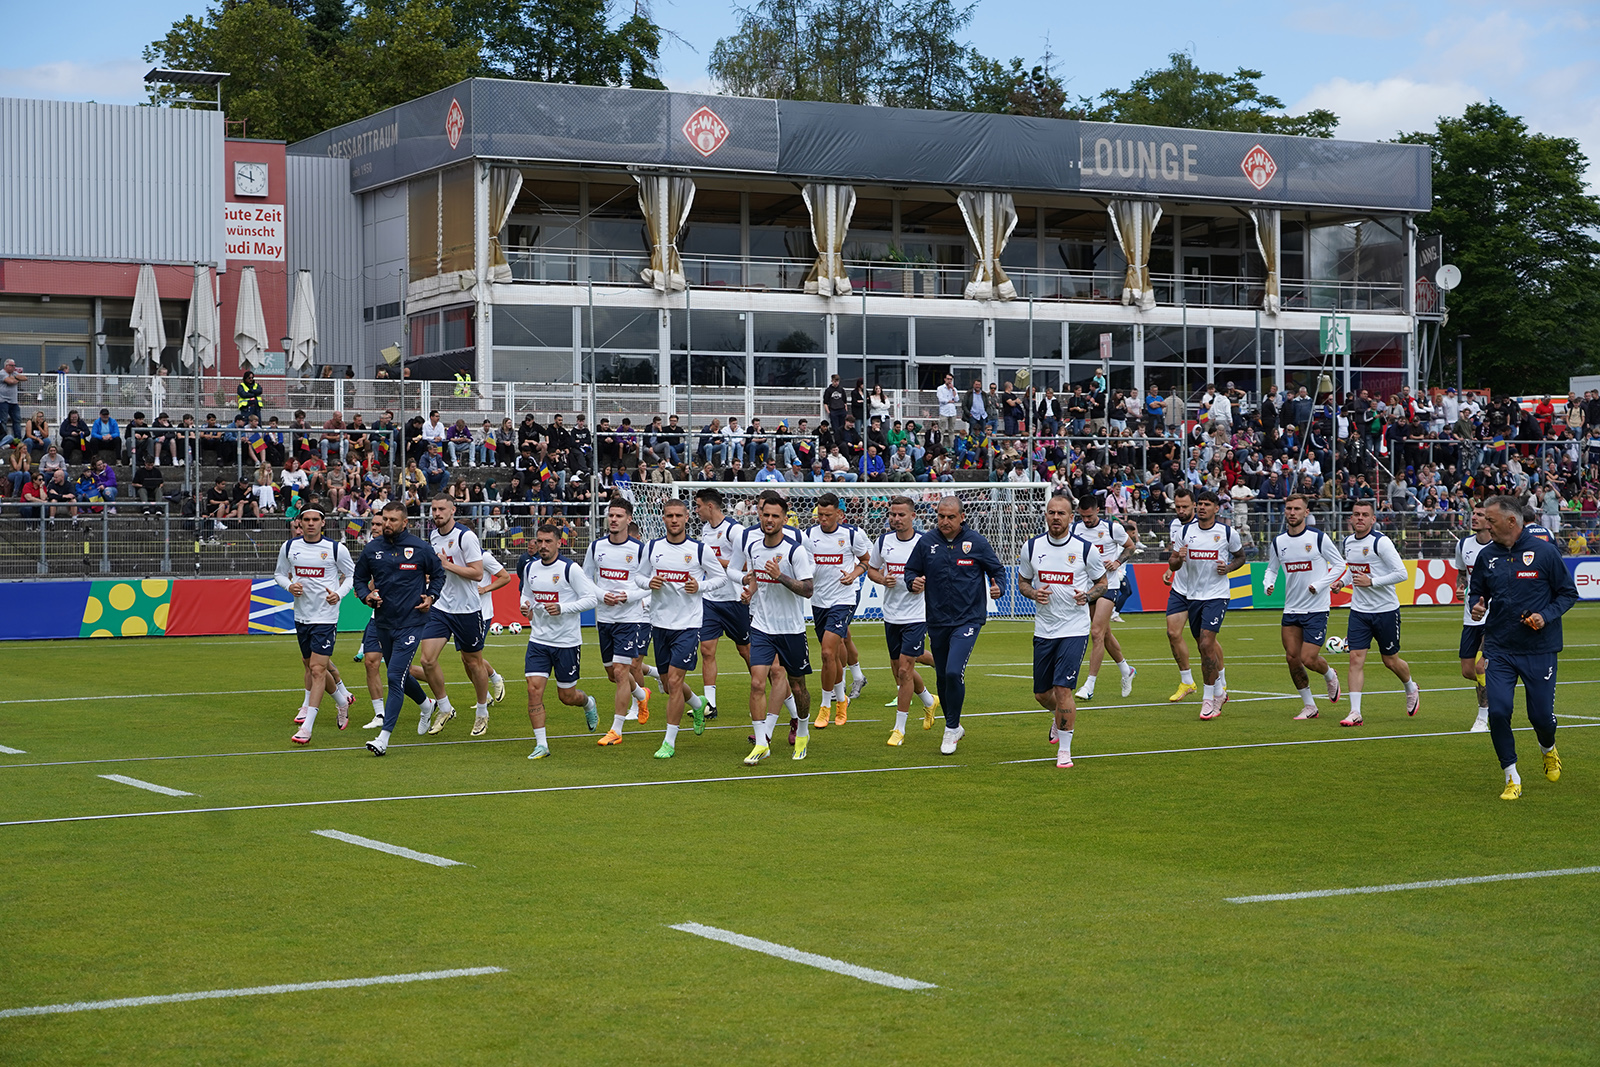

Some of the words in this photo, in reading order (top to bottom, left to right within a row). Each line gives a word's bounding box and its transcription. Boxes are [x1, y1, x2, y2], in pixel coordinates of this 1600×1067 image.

[1080, 137, 1199, 182] LOUNGE
[225, 207, 252, 221] ute
[255, 208, 282, 222] Zeit
[227, 225, 275, 238] wünscht
[225, 241, 250, 254] udi
[254, 242, 282, 259] May
